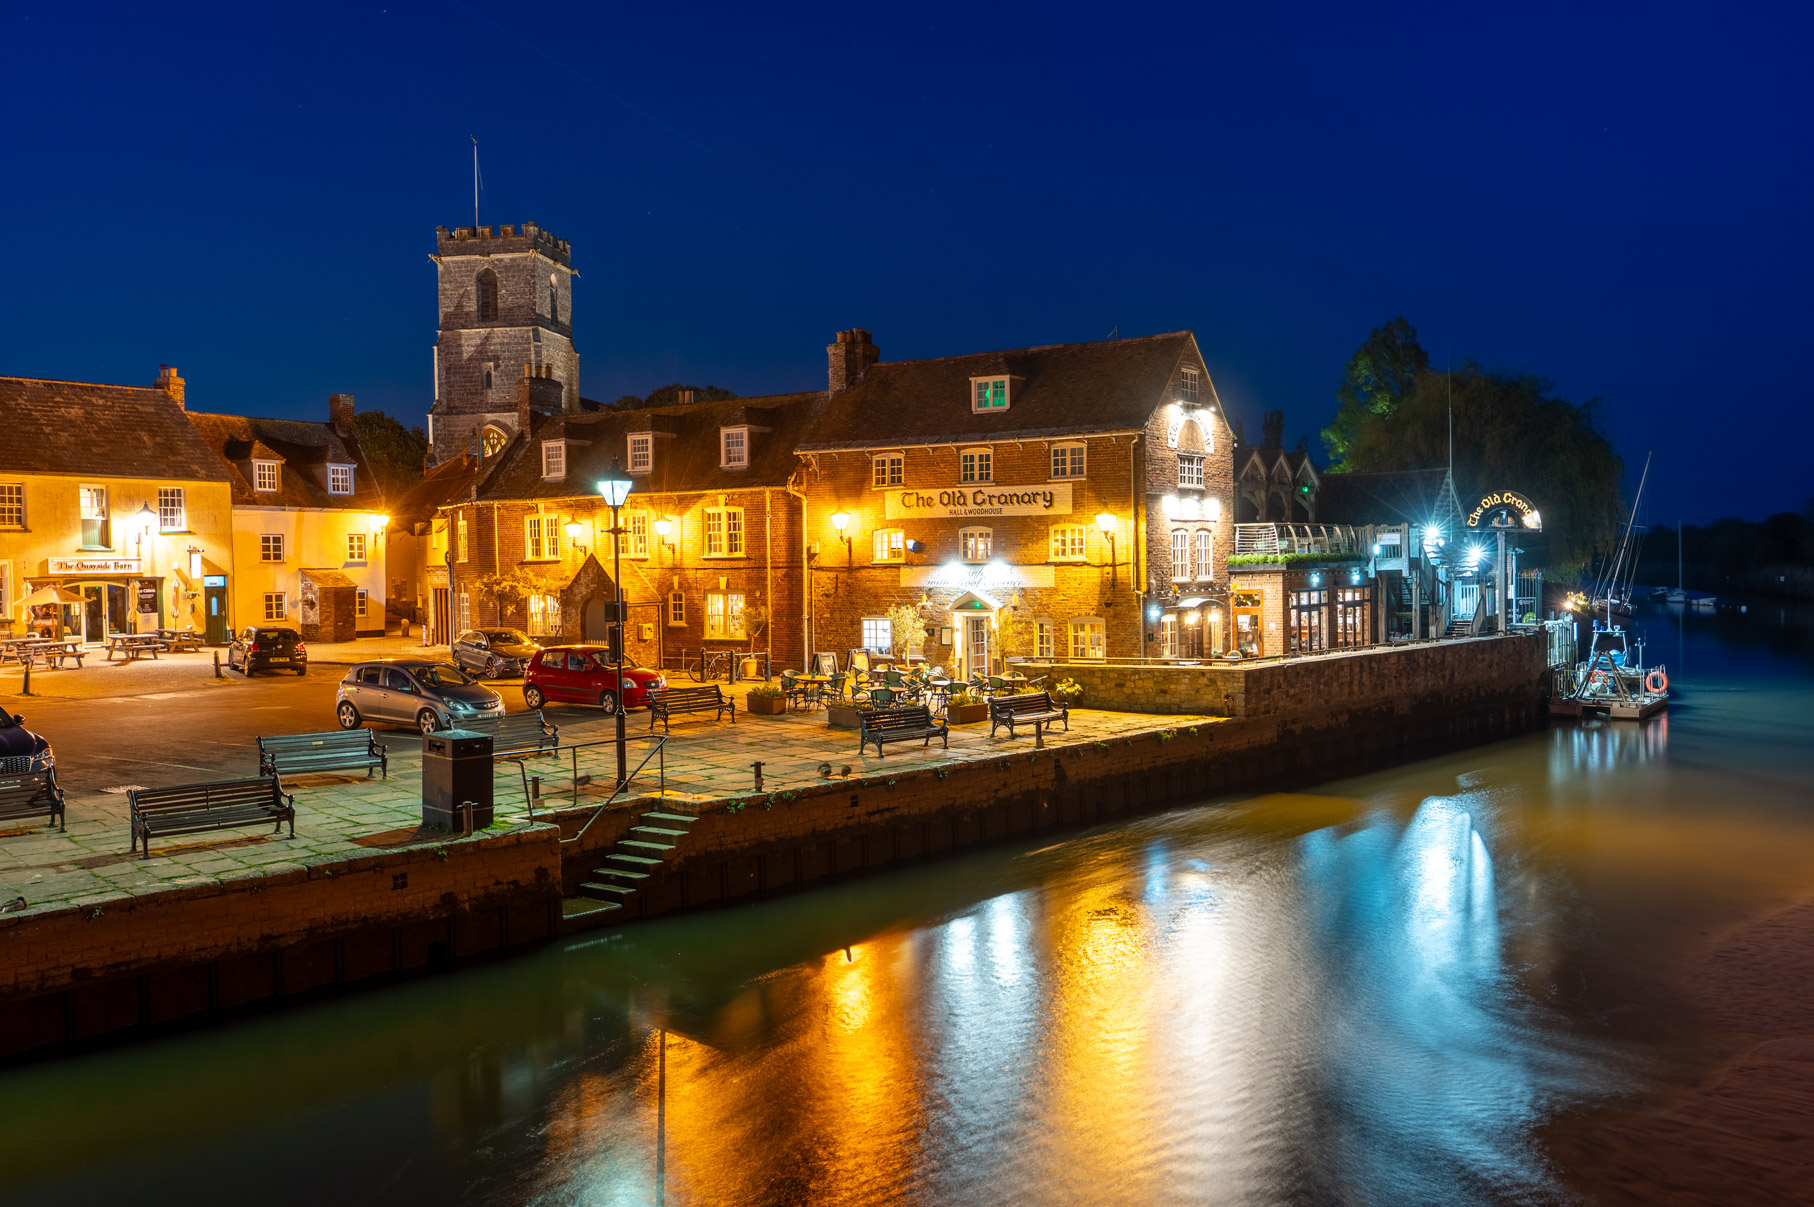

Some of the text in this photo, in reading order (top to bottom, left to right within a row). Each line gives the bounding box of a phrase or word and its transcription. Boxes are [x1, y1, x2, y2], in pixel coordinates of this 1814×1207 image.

[901, 489, 1054, 509] The Old Granary
[948, 508, 963, 516] HALL
[1466, 506, 1484, 527] The
[1481, 493, 1501, 508] Old
[56, 561, 73, 569] The
[77, 561, 111, 571] Quayside
